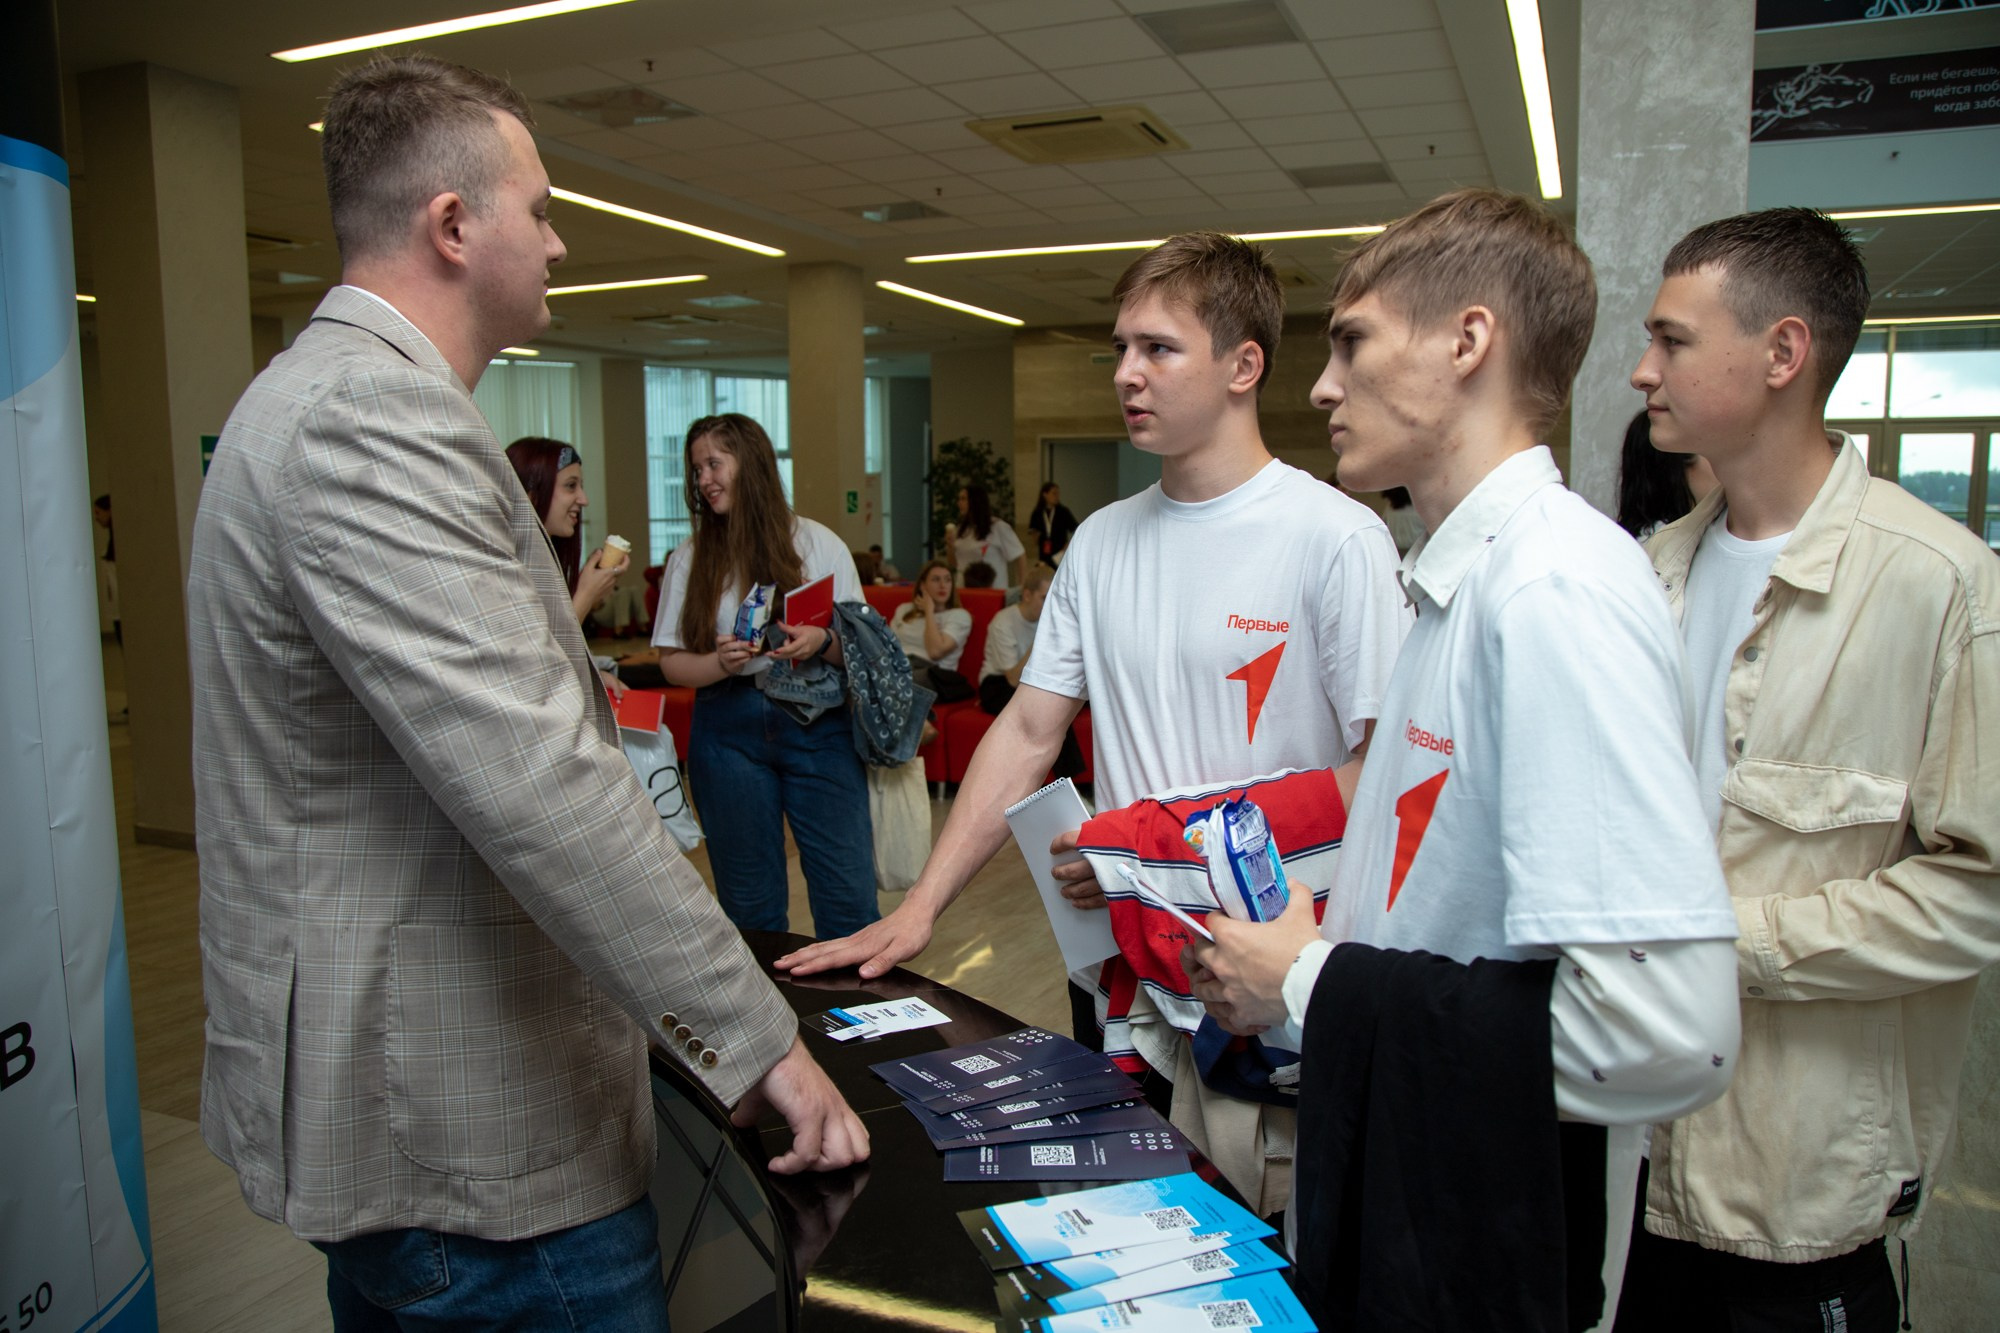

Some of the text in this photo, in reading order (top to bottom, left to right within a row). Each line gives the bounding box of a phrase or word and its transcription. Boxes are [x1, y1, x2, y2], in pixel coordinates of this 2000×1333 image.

[1889, 72, 1920, 85] Если
[1922, 71, 1938, 81] не
[1910, 79, 2000, 100] придётся поб
[1934, 100, 1971, 113] когда
[1227, 614, 1289, 634] Первые
[18, 1281, 53, 1332] 50
